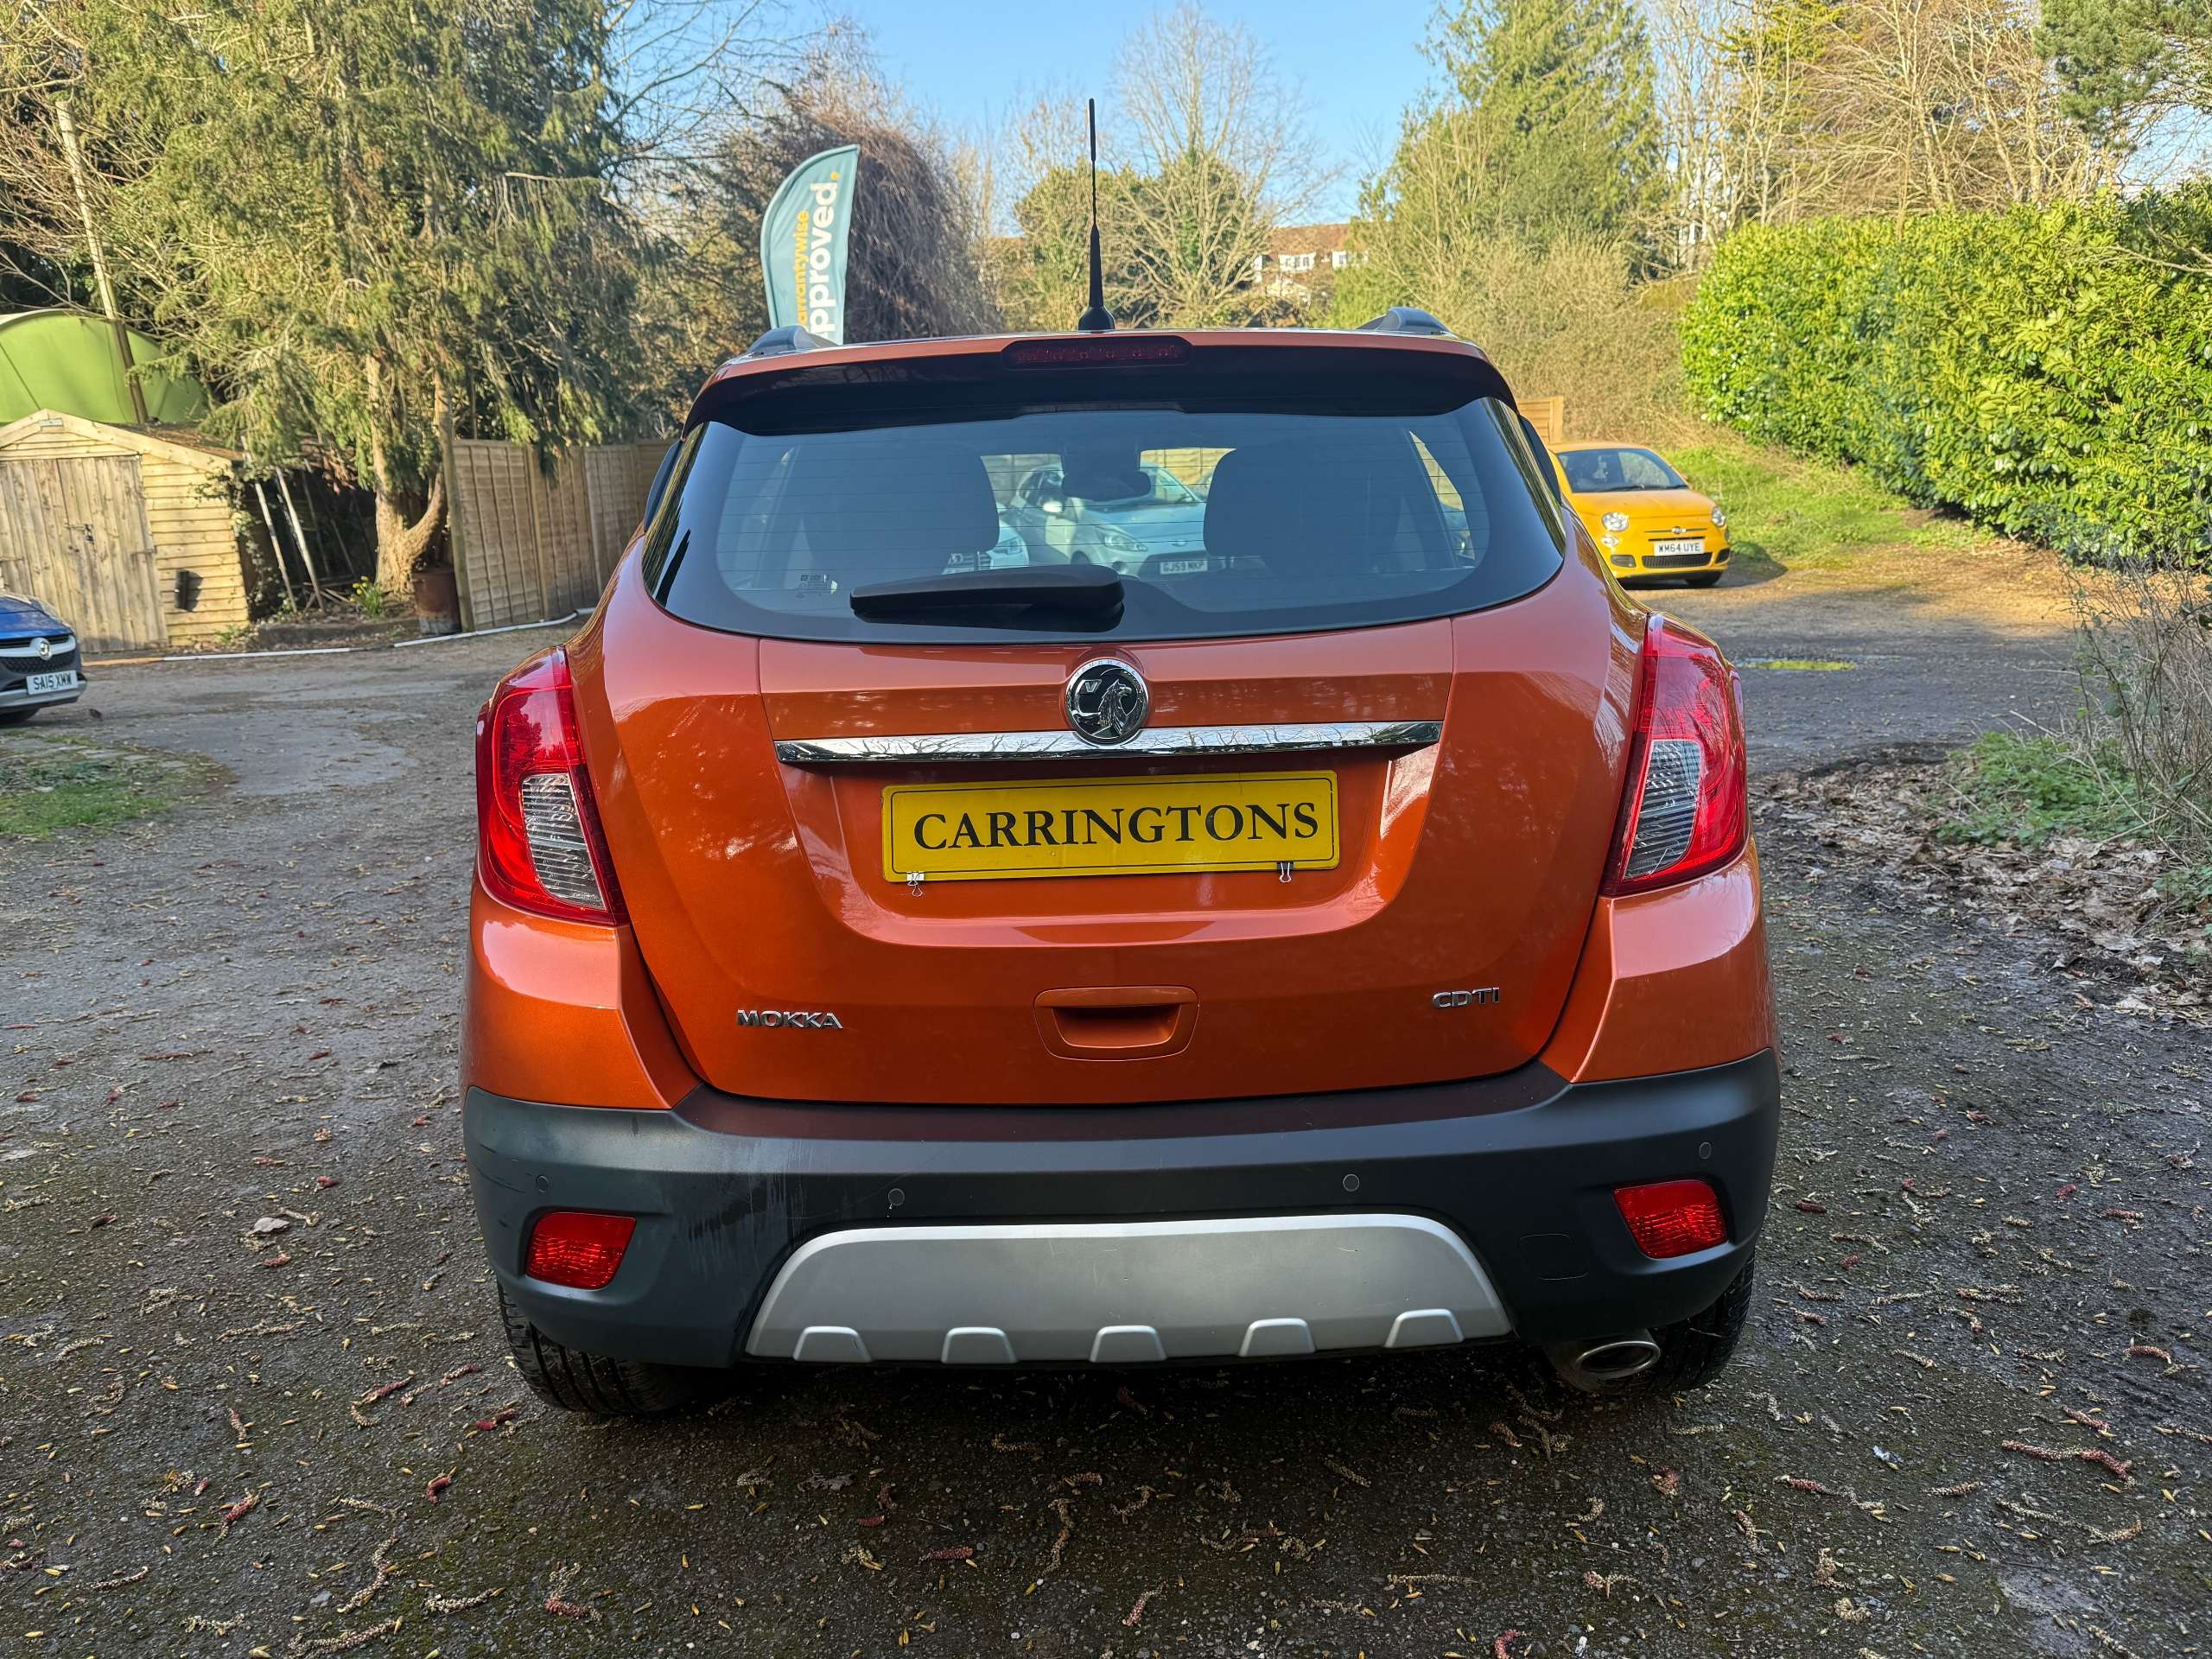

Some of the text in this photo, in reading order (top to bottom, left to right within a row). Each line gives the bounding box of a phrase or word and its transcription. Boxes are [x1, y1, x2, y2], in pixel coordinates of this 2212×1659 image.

[809, 171, 839, 337] pproved.
[793, 210, 810, 325] arrantywise
[1658, 542, 1700, 553] WM64 UYE
[33, 675, 54, 690] SA15
[914, 801, 1319, 850] CARRINGTONS
[1433, 987, 1500, 1009] CDTI
[737, 1009, 843, 1029] MOKKA
